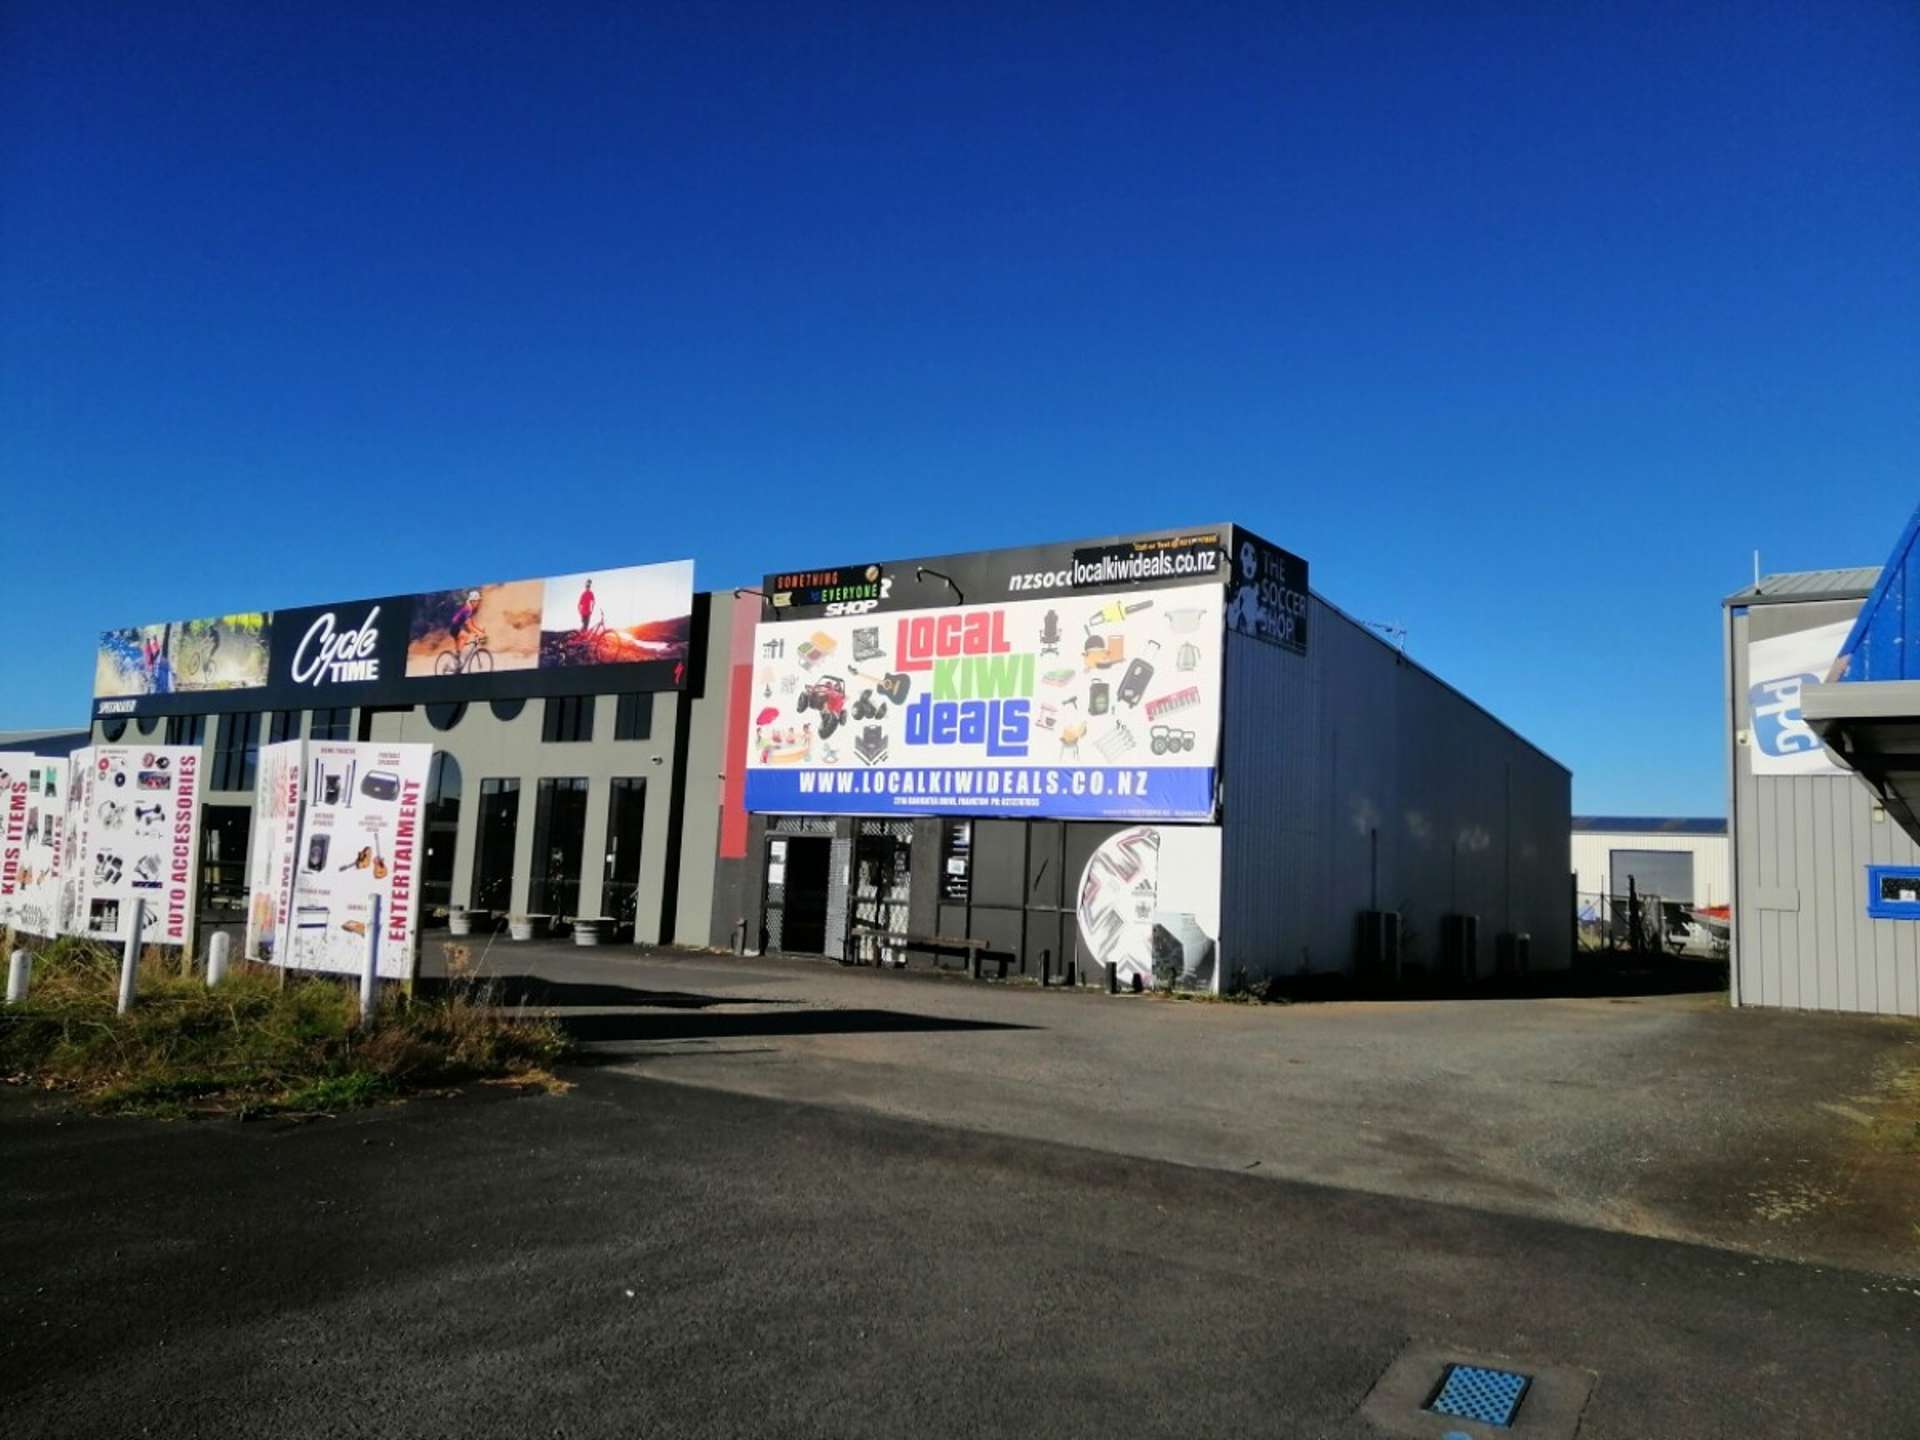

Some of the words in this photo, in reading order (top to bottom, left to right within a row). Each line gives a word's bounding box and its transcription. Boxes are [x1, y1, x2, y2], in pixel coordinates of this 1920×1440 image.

[777, 570, 839, 589] SOMETHING
[1074, 550, 1216, 585] localkiwideals.co.nz
[1263, 552, 1286, 581] THE
[821, 583, 879, 602] EVERYONE
[825, 600, 879, 616] SHOP
[1261, 578, 1307, 618] SOCCER
[1261, 608, 1295, 641] SHOP
[291, 605, 381, 687] Cycle
[330, 659, 379, 683] TIME
[933, 653, 1036, 701] KIWI
[799, 768, 1149, 797] WWW.LOCALKIWIDEALS.CO.NZ
[7, 781, 28, 841] ITEMS
[171, 755, 197, 884] ACCESSORIES
[277, 854, 292, 925] HOME
[285, 765, 299, 844] ITEMS
[388, 780, 421, 942] ENTERTAIMENT
[1, 847, 20, 895] KIDS
[168, 888, 187, 938] AUTO
